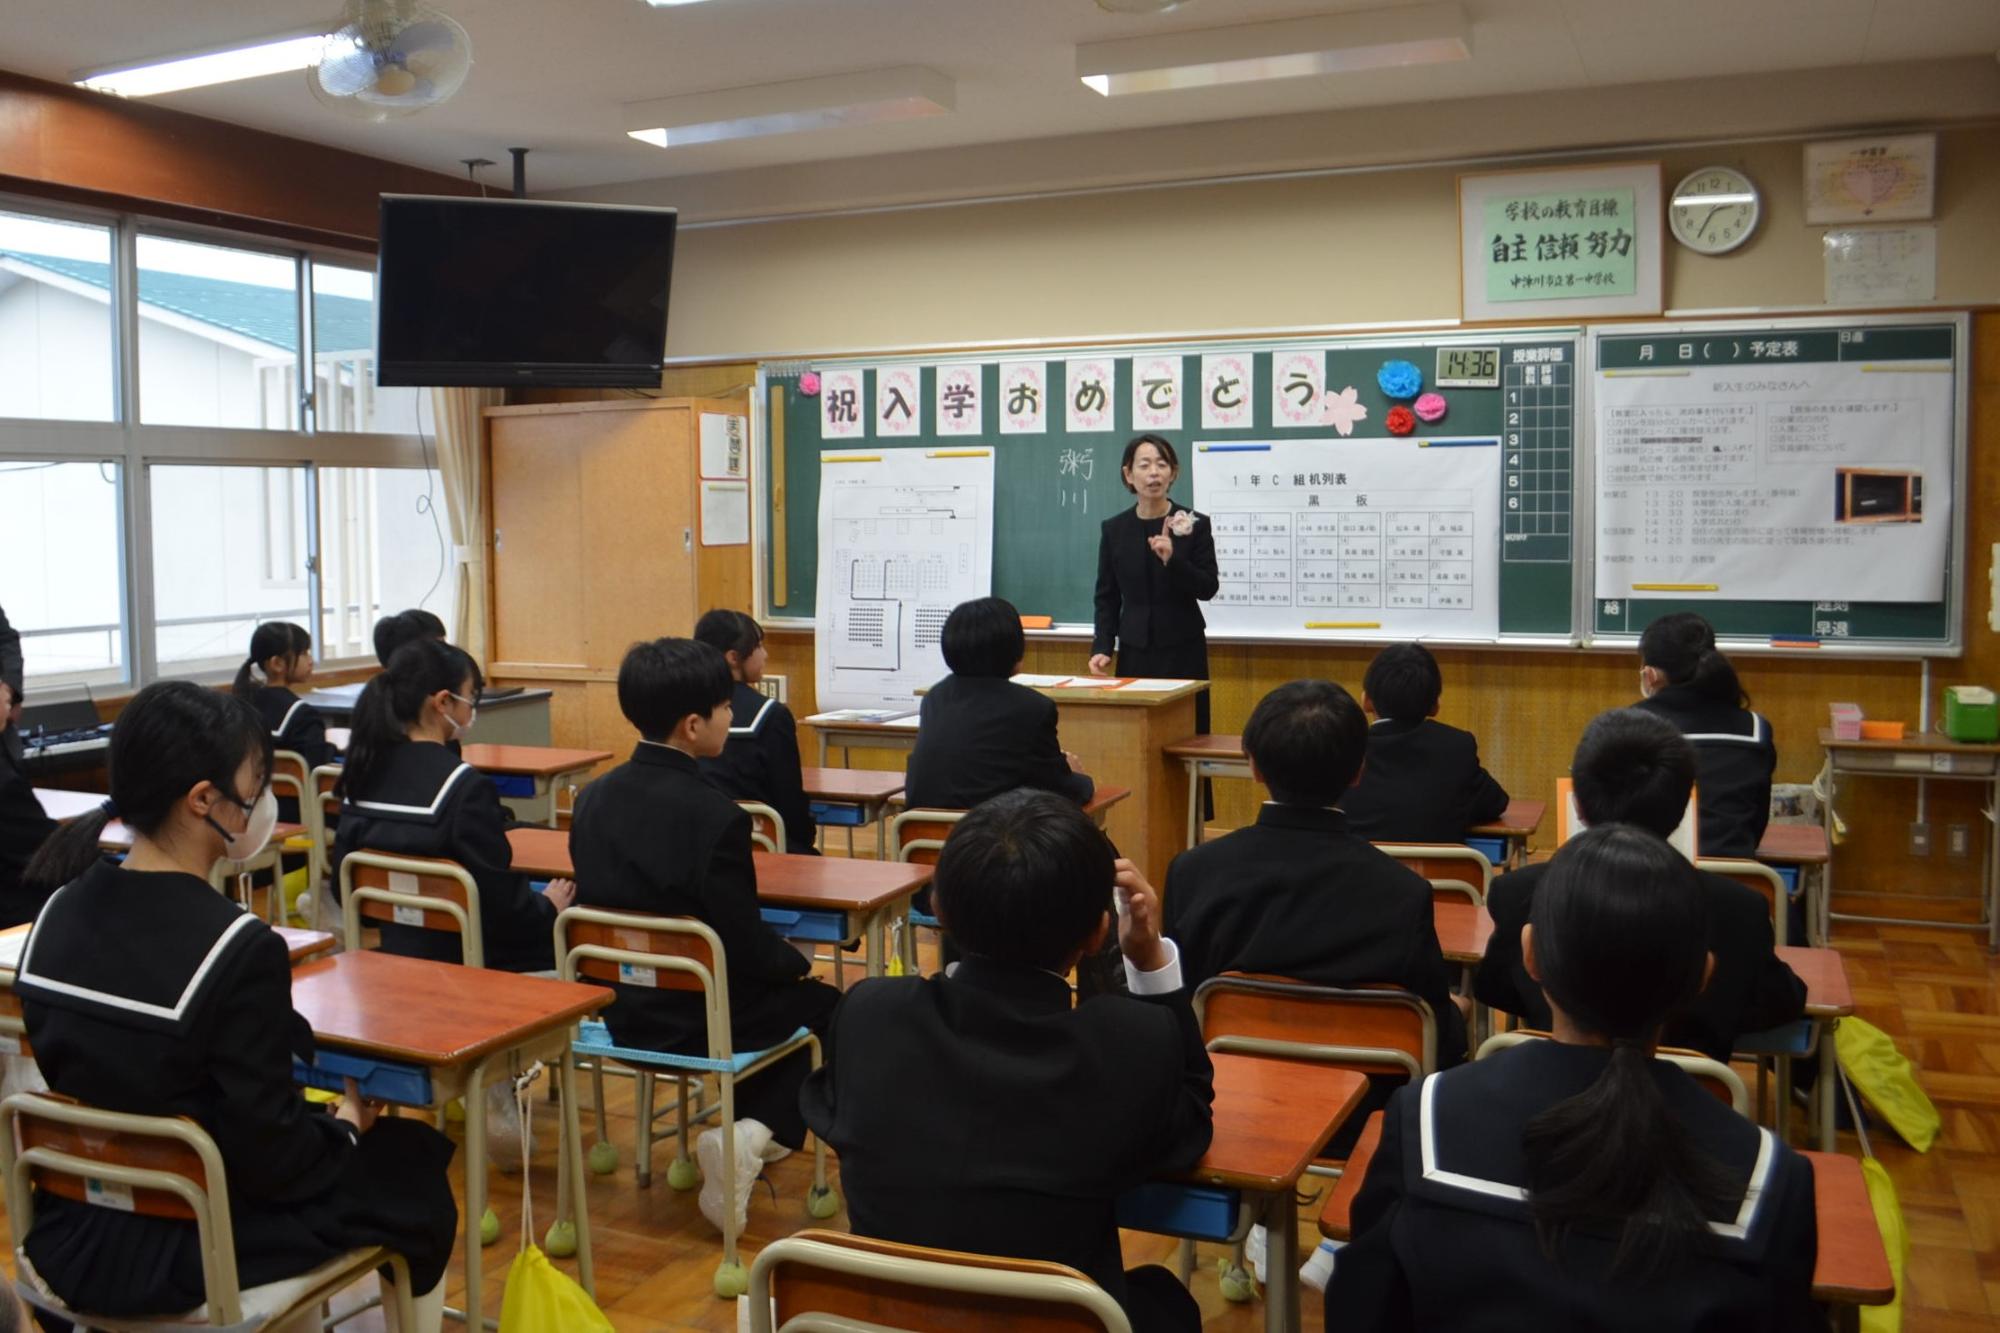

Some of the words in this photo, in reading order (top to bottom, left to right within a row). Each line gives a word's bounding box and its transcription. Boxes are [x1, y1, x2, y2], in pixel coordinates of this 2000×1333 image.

[1710, 178, 1720, 188] 12
[1505, 199, 1619, 221] 学校の教育目標
[1492, 233, 1527, 263] 自主
[1536, 232, 1579, 260] 信頼
[1585, 228, 1632, 259] 努力
[1510, 271, 1616, 289] 中津川市立第一中学校
[1513, 348, 1563, 363] 授業評価
[1639, 345, 1654, 360] 月
[1448, 351, 1494, 377] 14:36
[1510, 392, 1517, 403] 1
[1509, 413, 1518, 424] 2
[1508, 434, 1519, 446] 3
[1508, 454, 1519, 465] 4
[1508, 475, 1519, 487] 5
[1508, 497, 1518, 509] 6
